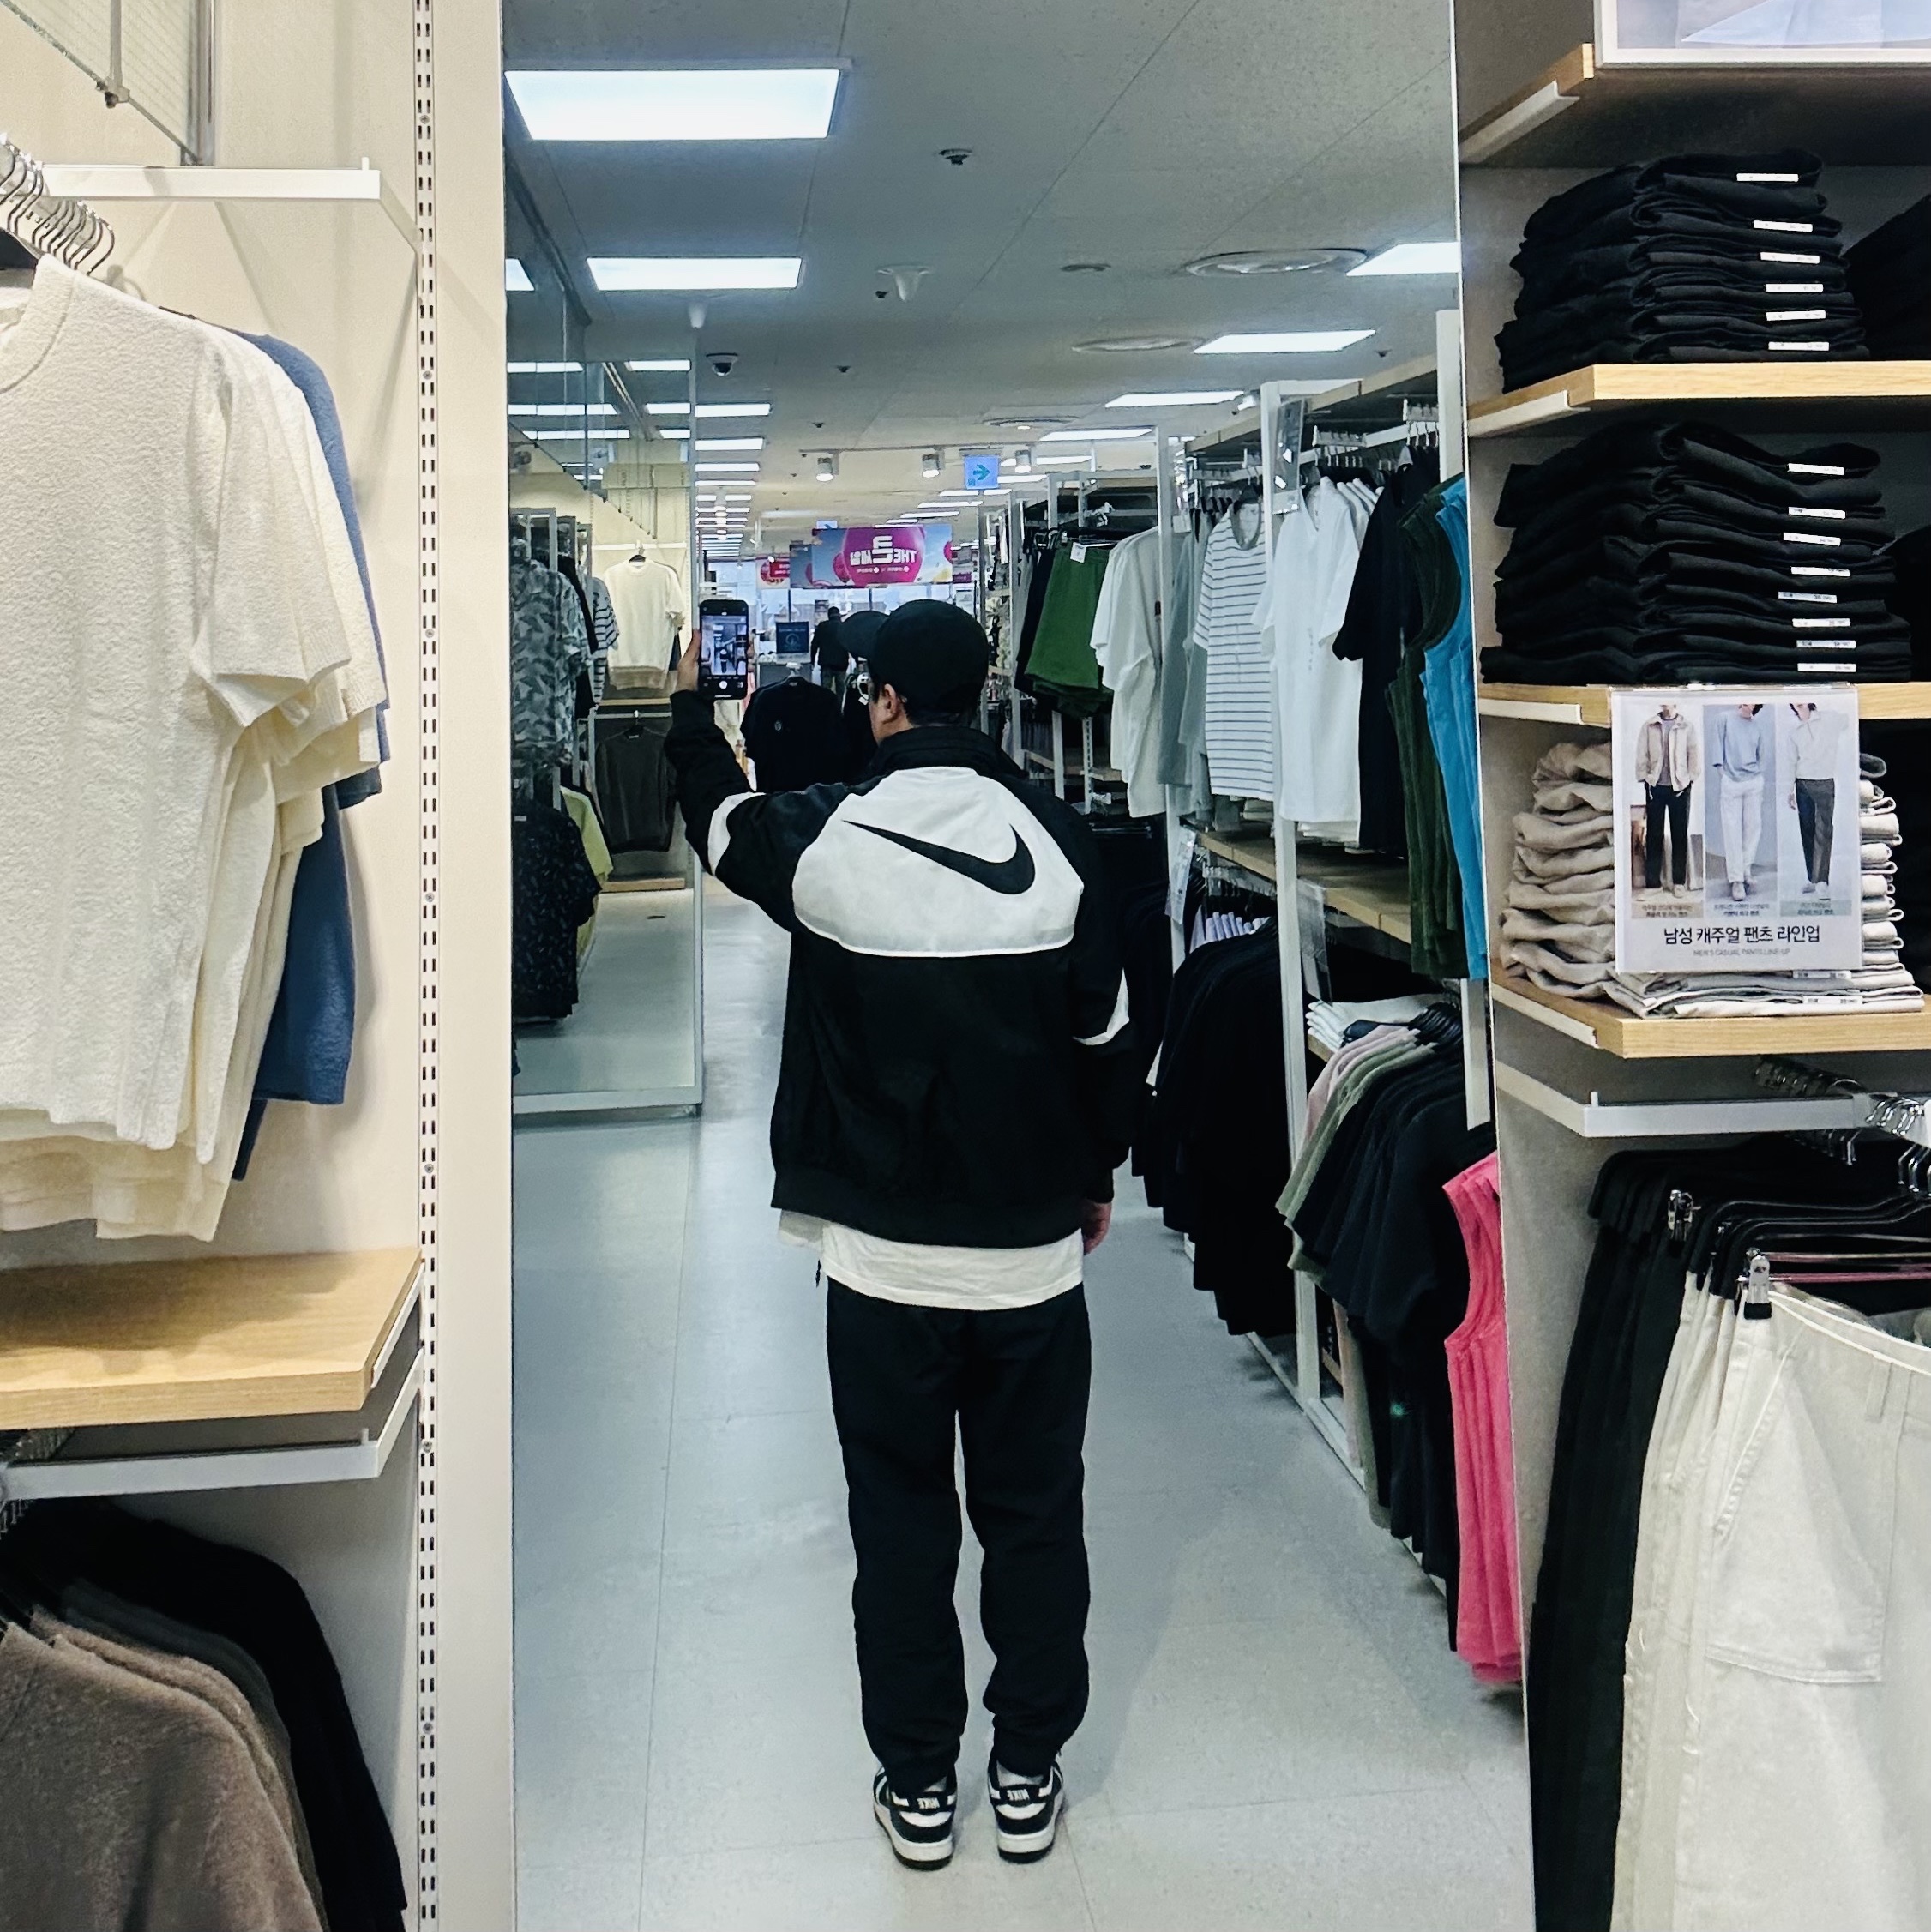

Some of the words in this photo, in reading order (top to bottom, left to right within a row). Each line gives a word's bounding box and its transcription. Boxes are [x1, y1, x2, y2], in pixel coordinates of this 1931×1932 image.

[1664, 927, 1693, 945] 남성
[1696, 926, 1740, 944] 캐주얼
[1744, 926, 1773, 943] 팬츠
[1778, 925, 1820, 942] 라인업
